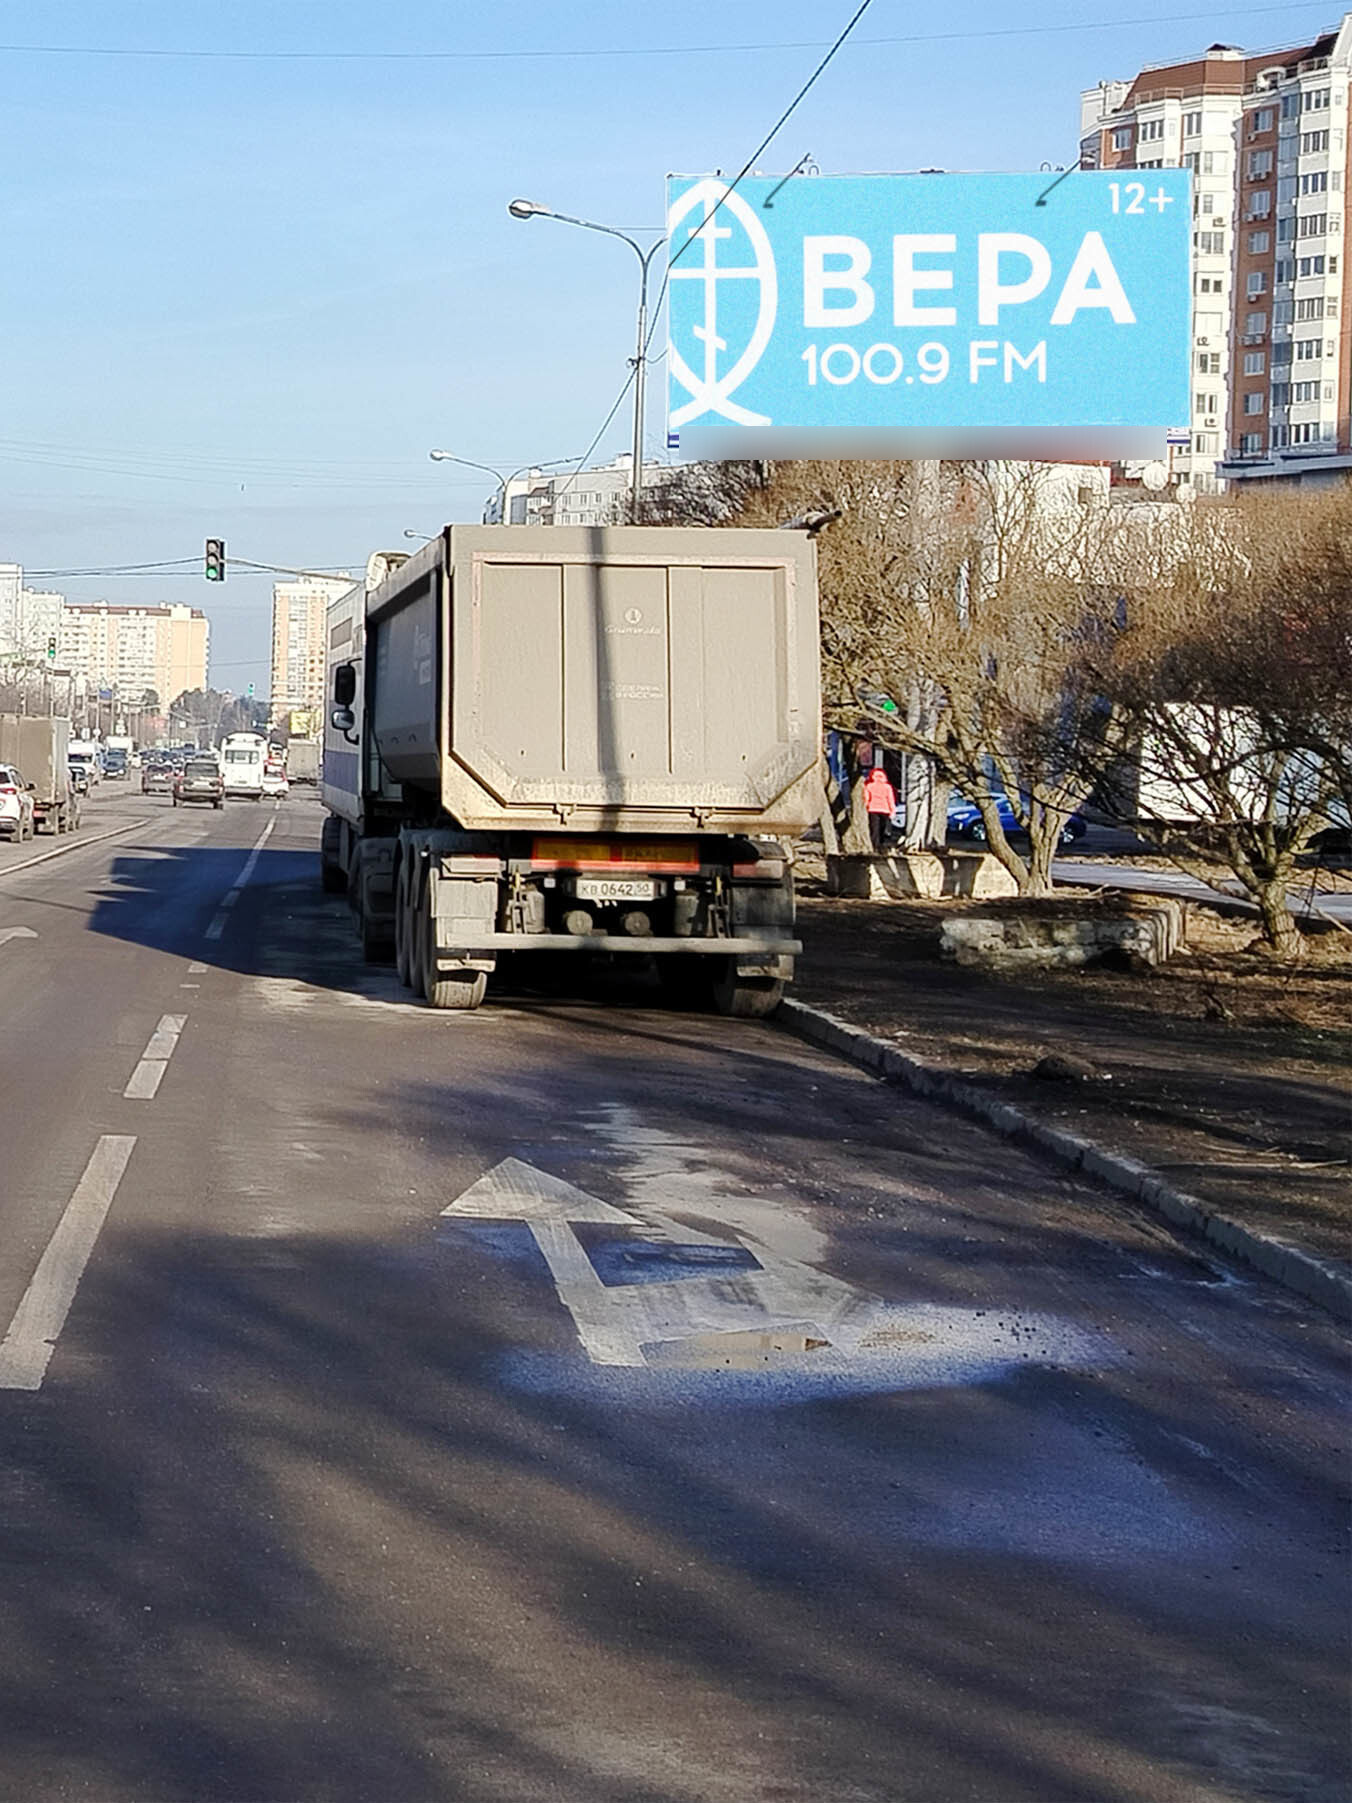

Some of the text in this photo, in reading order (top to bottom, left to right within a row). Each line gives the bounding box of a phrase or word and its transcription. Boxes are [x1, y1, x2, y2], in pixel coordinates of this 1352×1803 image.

[1109, 182, 1174, 214] 12+
[802, 231, 1137, 328] ВЕРА
[801, 340, 1047, 385] 100.9 FM
